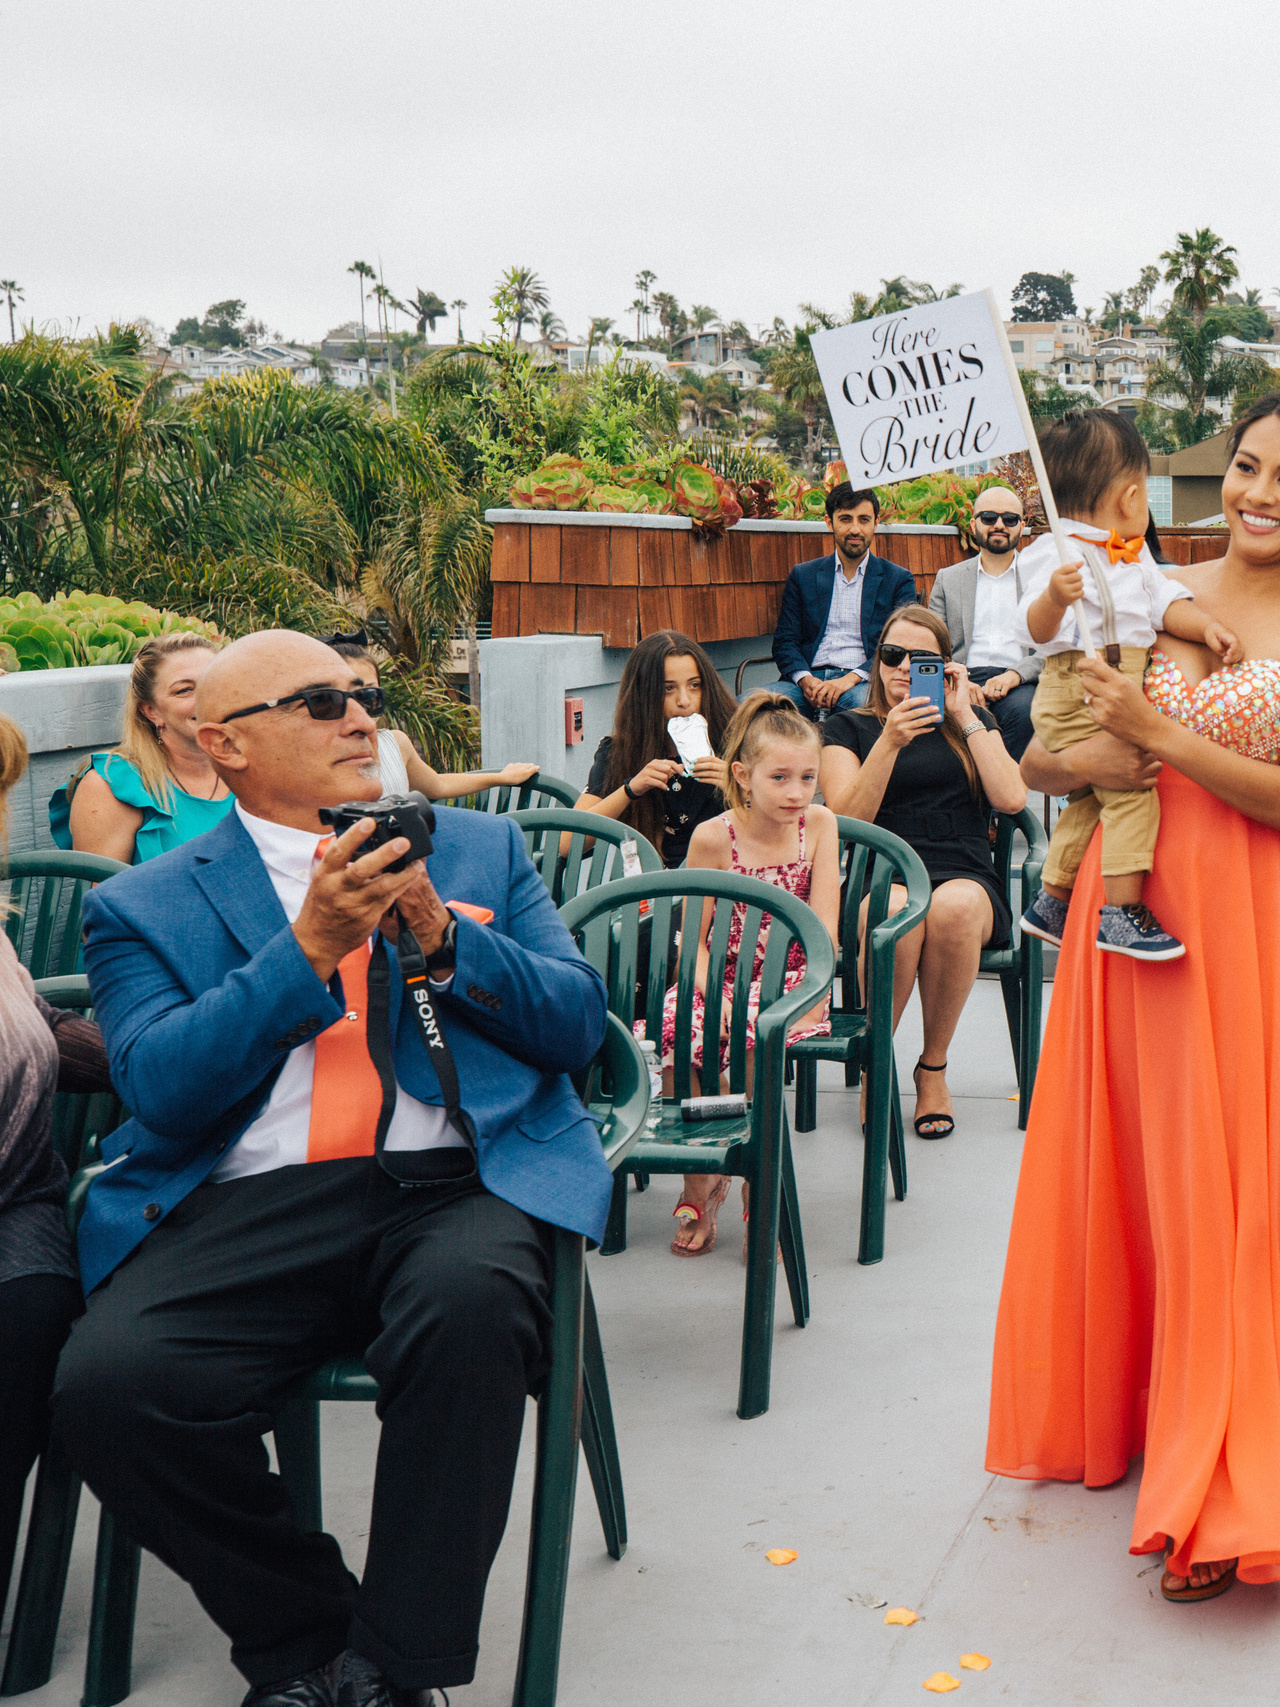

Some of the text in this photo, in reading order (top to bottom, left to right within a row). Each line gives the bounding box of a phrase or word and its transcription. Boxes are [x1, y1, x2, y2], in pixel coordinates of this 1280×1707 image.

[872, 317, 941, 360] Here
[842, 343, 983, 407] COMES
[899, 391, 947, 418] THE
[860, 397, 999, 479] Bride
[413, 988, 444, 1049] SONY
